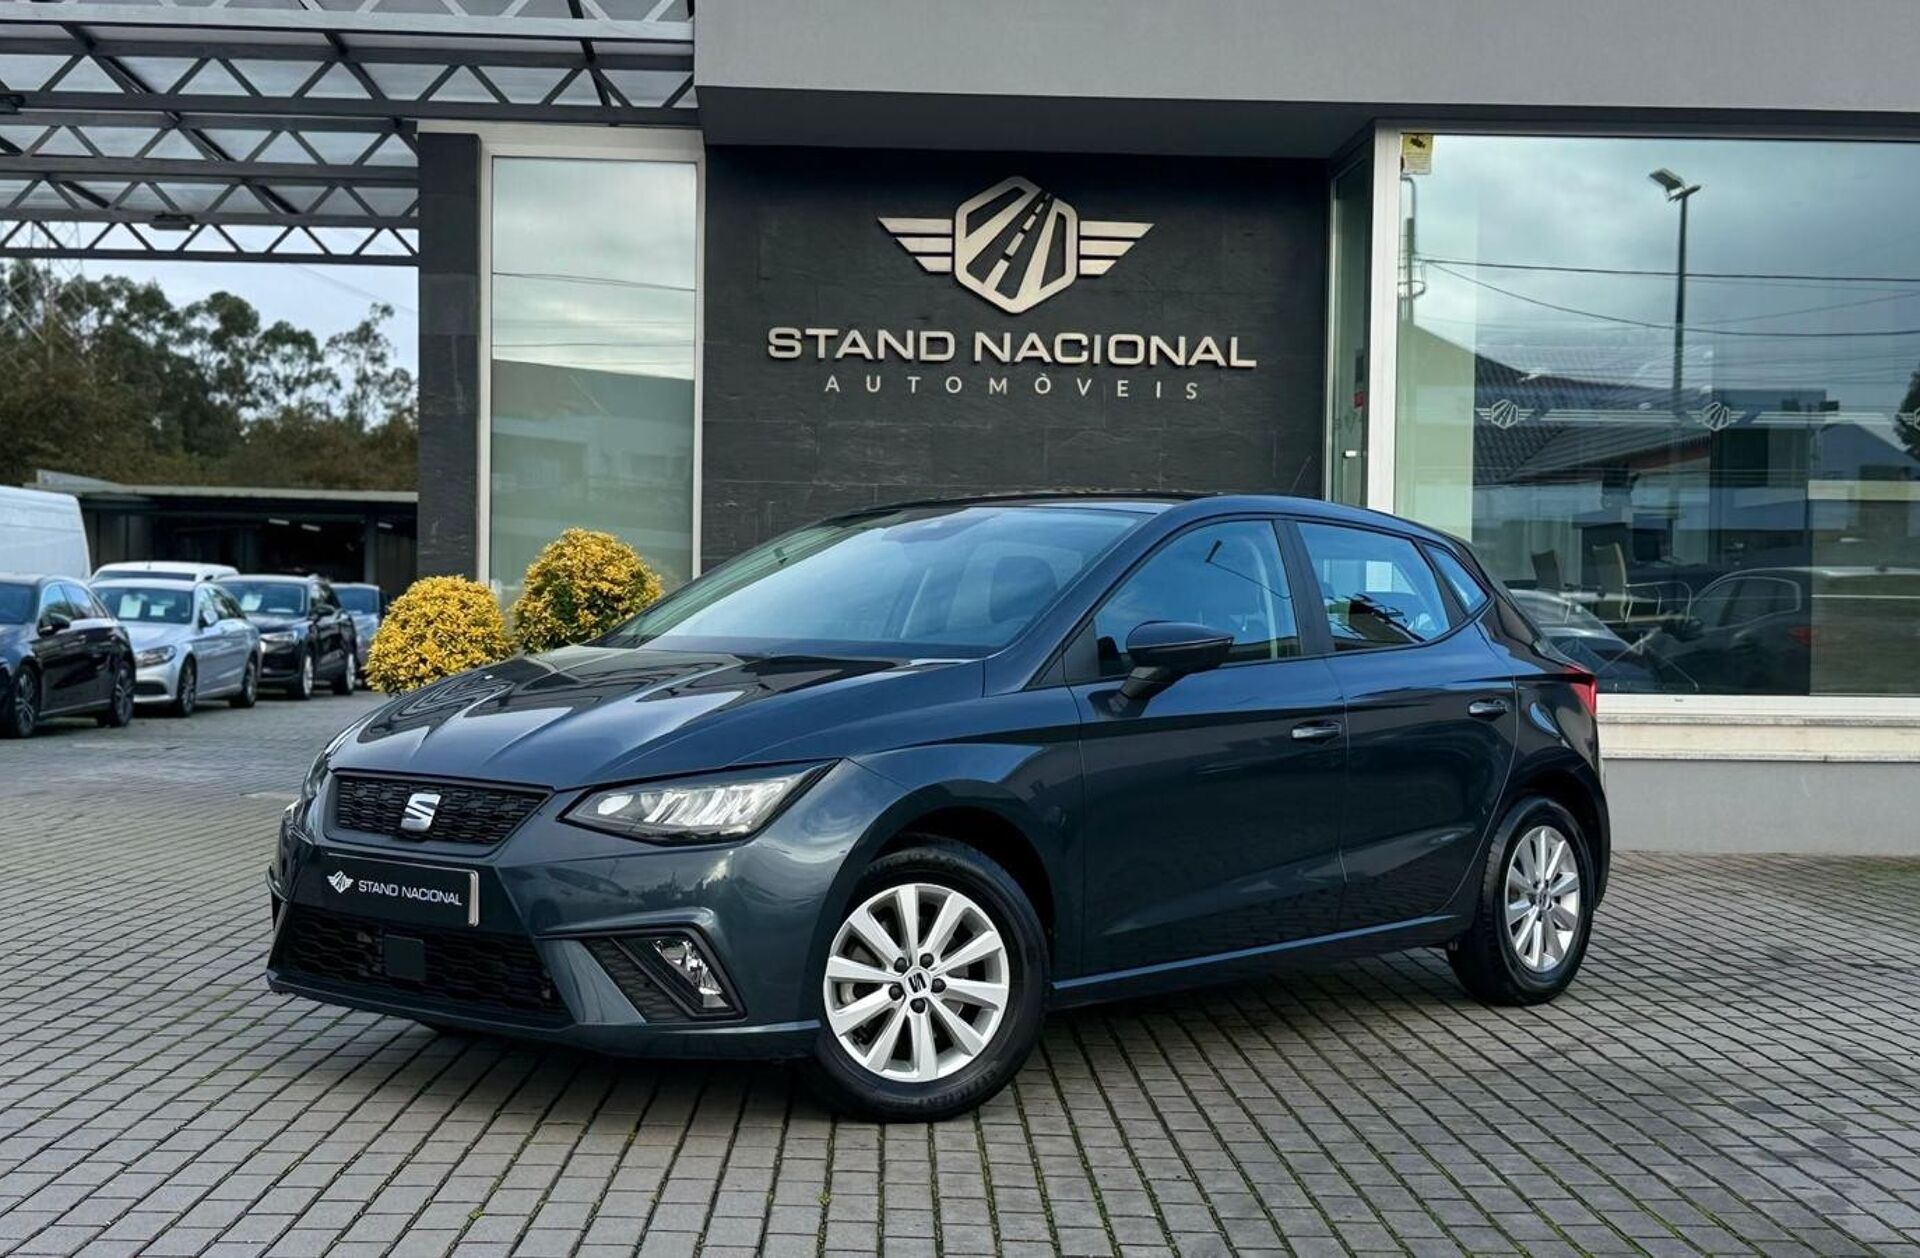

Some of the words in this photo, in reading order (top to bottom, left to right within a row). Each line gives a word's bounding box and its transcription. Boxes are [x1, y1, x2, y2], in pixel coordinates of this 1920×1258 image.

[767, 327, 956, 362] STAND
[973, 331, 1258, 368] NACIONAL
[358, 879, 399, 896] STAND
[401, 885, 463, 906] NACIONAL
